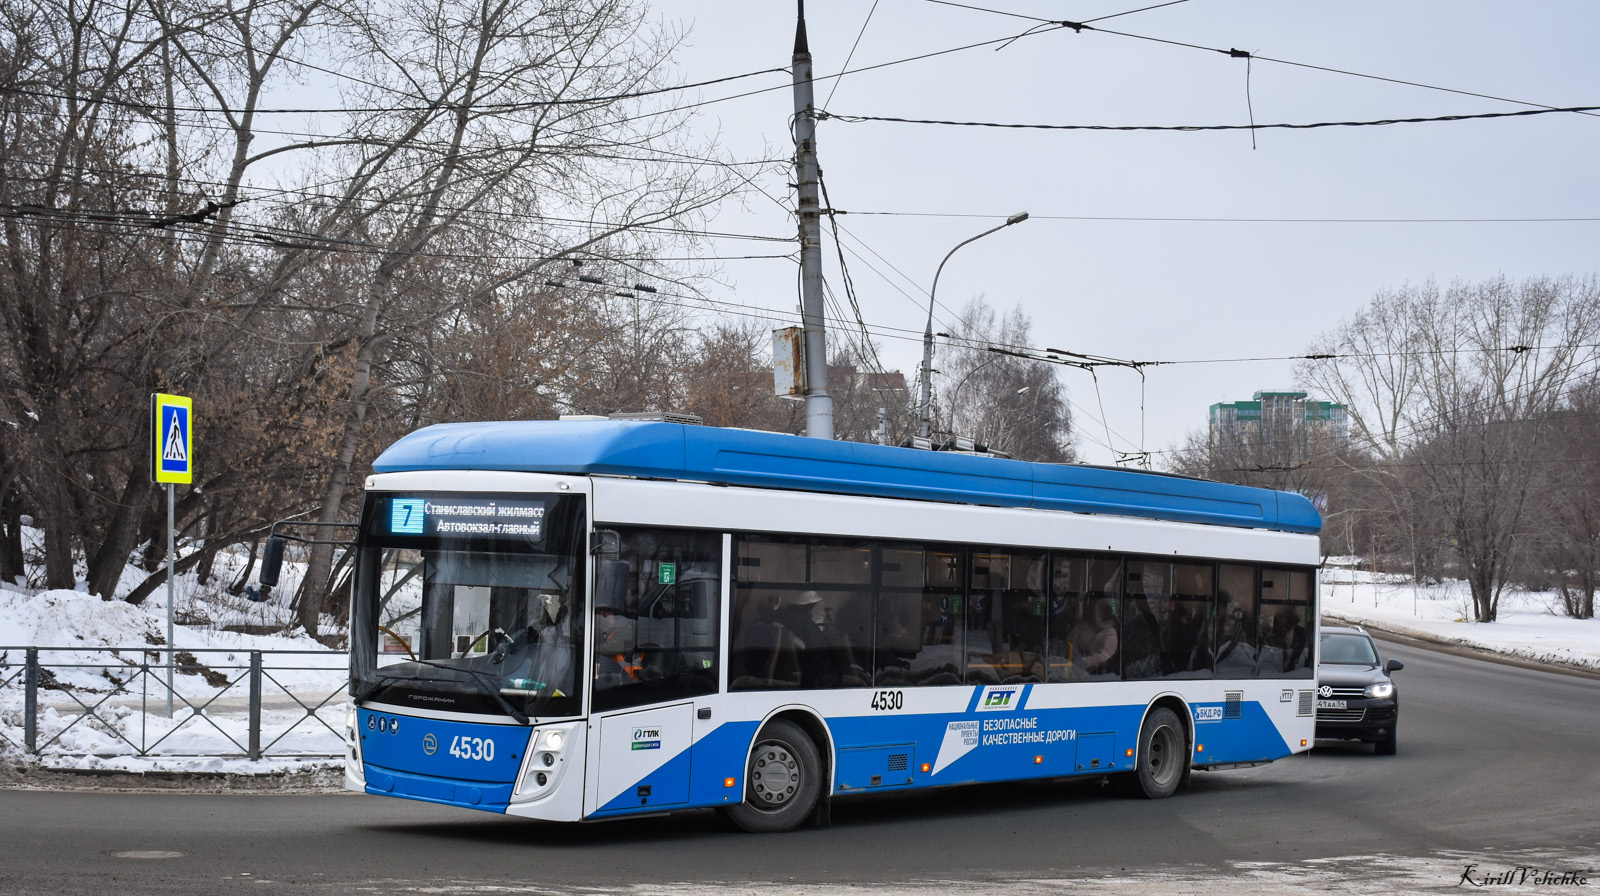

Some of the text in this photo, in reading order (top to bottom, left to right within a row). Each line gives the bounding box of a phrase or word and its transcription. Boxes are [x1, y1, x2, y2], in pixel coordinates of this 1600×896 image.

[402, 504, 412, 527] 7
[424, 502, 545, 517] Станиславский жилмасс
[436, 519, 540, 535] Автовокзал-главный
[408, 694, 456, 704] ГОРОЖАНИН
[870, 690, 904, 711] 4530
[1200, 708, 1222, 719] БКД.РФ
[948, 721, 979, 731] НАЦИОНАЛЬНЫЕ
[983, 717, 1038, 732] БЕЗОПАСНЫЕ
[643, 730, 659, 738] ГТЛК
[960, 730, 978, 738] ПРОЕКТЫ
[982, 729, 1076, 746] КАЧЕСТВЕННЫЕ ДОРОГИ
[449, 735, 495, 762] 4530
